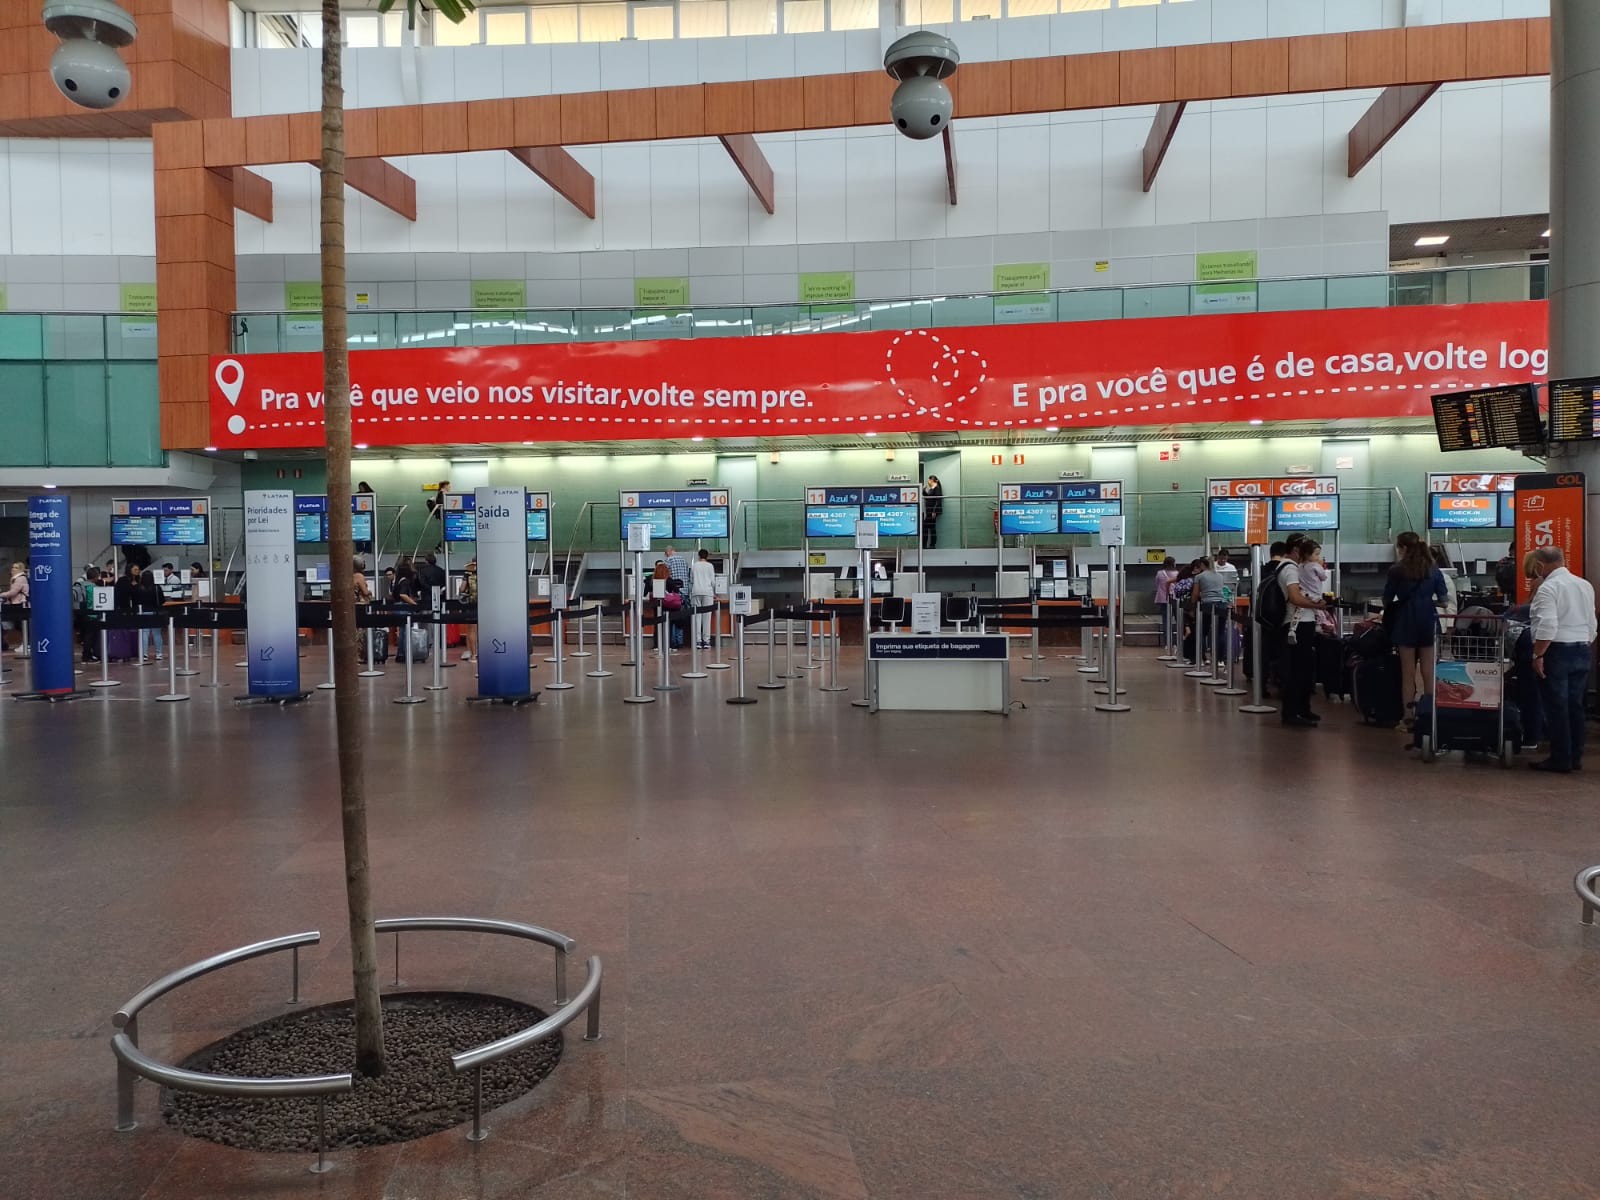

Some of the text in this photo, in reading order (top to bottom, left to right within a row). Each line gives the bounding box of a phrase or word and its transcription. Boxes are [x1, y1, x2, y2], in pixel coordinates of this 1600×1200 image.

[1012, 382, 1029, 407] E
[1038, 383, 1088, 412] pra
[1095, 367, 1168, 399] você
[1177, 364, 1237, 395] que
[1246, 355, 1265, 382] é
[1275, 351, 1315, 379] de
[261, 389, 299, 410] Pra
[306, 383, 364, 408] vê
[371, 388, 420, 416] que
[426, 380, 480, 405] veio
[489, 385, 534, 404] nos
[1433, 481, 1450, 491] 17
[1556, 474, 1583, 486] GOL
[1003, 487, 1118, 500] 13 Azul Azul 14
[1212, 485, 1228, 495] 15
[1235, 483, 1265, 495] GOL
[1317, 482, 1334, 493] 16
[451, 498, 544, 508] 7 8
[627, 497, 634, 507] 9
[712, 495, 727, 505] 10
[810, 491, 917, 503] 11 Azul Azul 12
[1452, 498, 1478, 508] GOL
[1294, 502, 1321, 511] GOL
[49, 509, 60, 518] de
[98, 592, 108, 604] B
[876, 643, 902, 651] Imprima
[914, 643, 940, 651] etiqueta
[950, 642, 980, 650] bagagem
